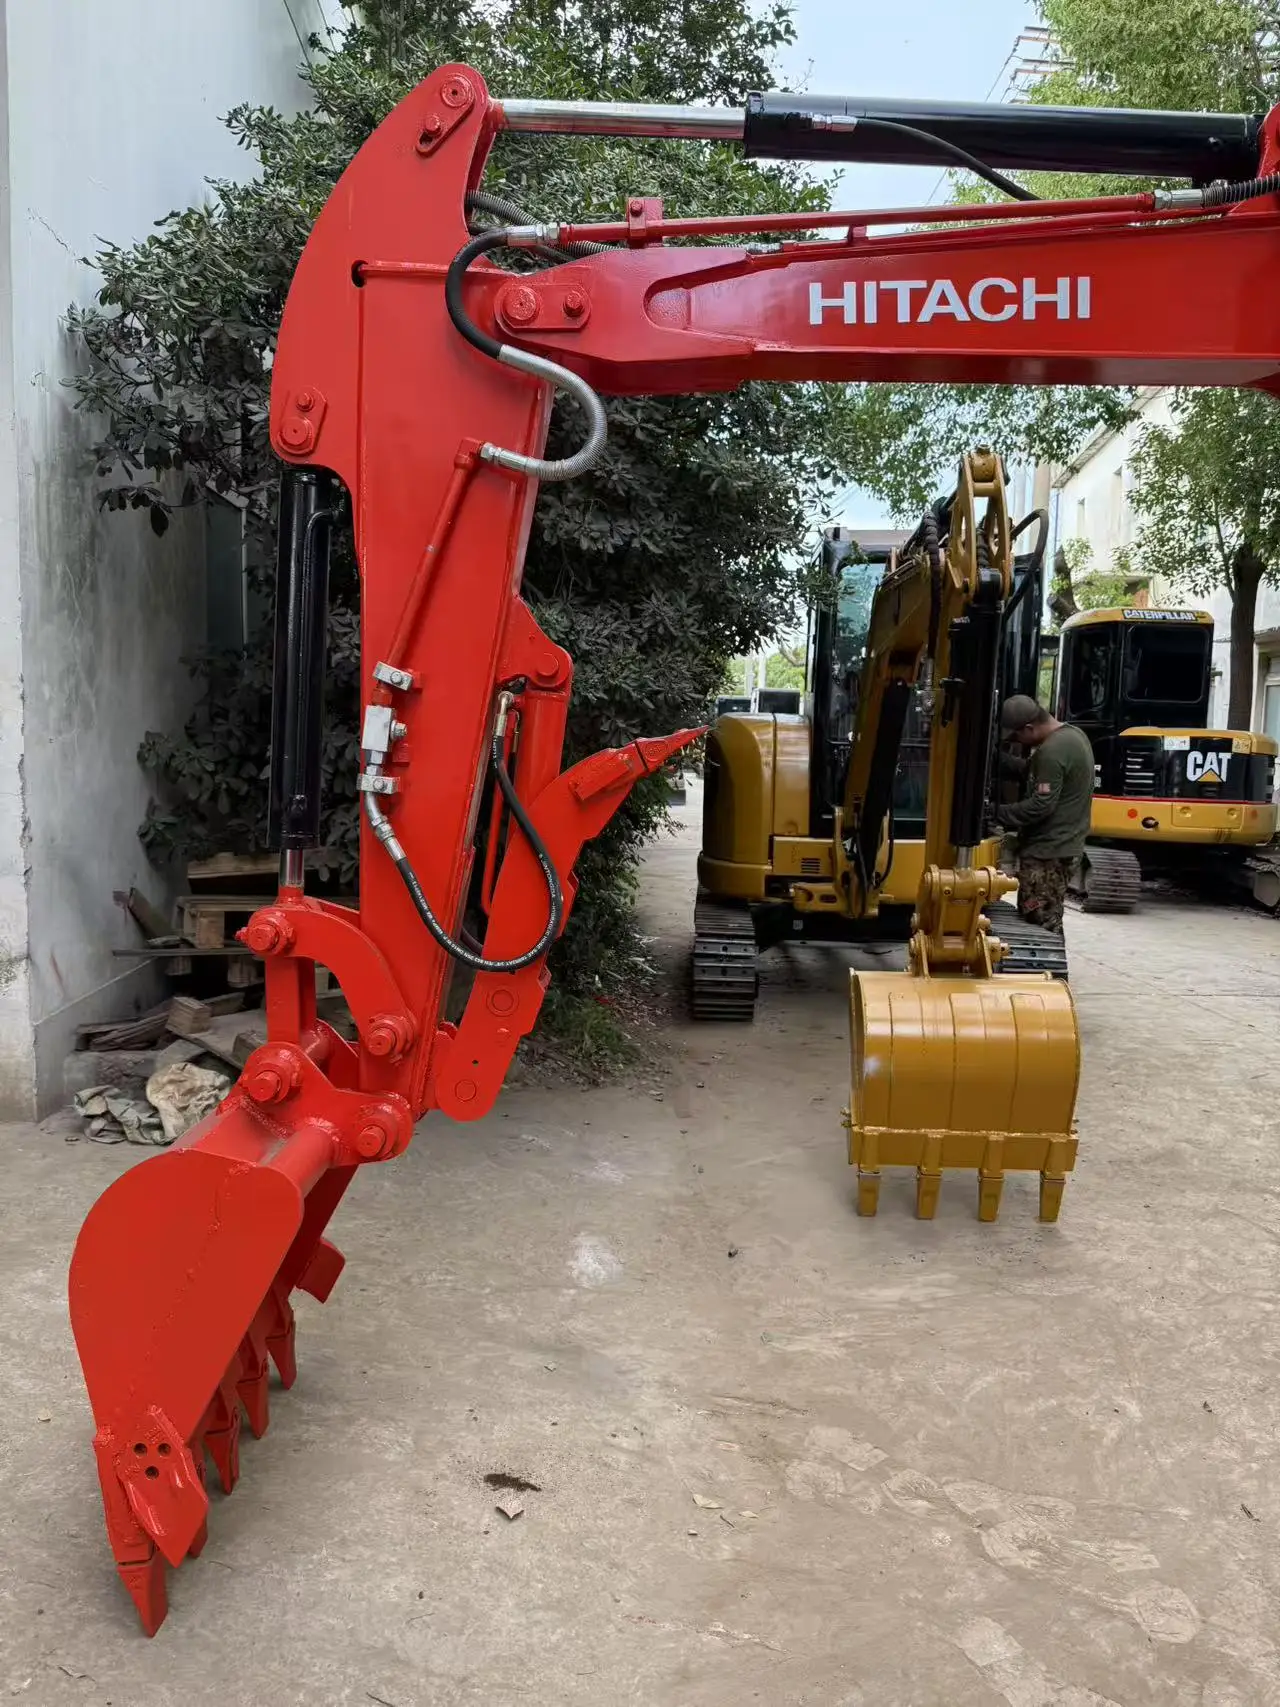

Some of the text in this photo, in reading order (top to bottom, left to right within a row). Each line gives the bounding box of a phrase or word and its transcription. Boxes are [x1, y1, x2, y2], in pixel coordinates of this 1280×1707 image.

[809, 276, 1090, 325] HITACHI
[1123, 609, 1197, 621] CATERPILLAR
[1186, 751, 1232, 783] CAT
